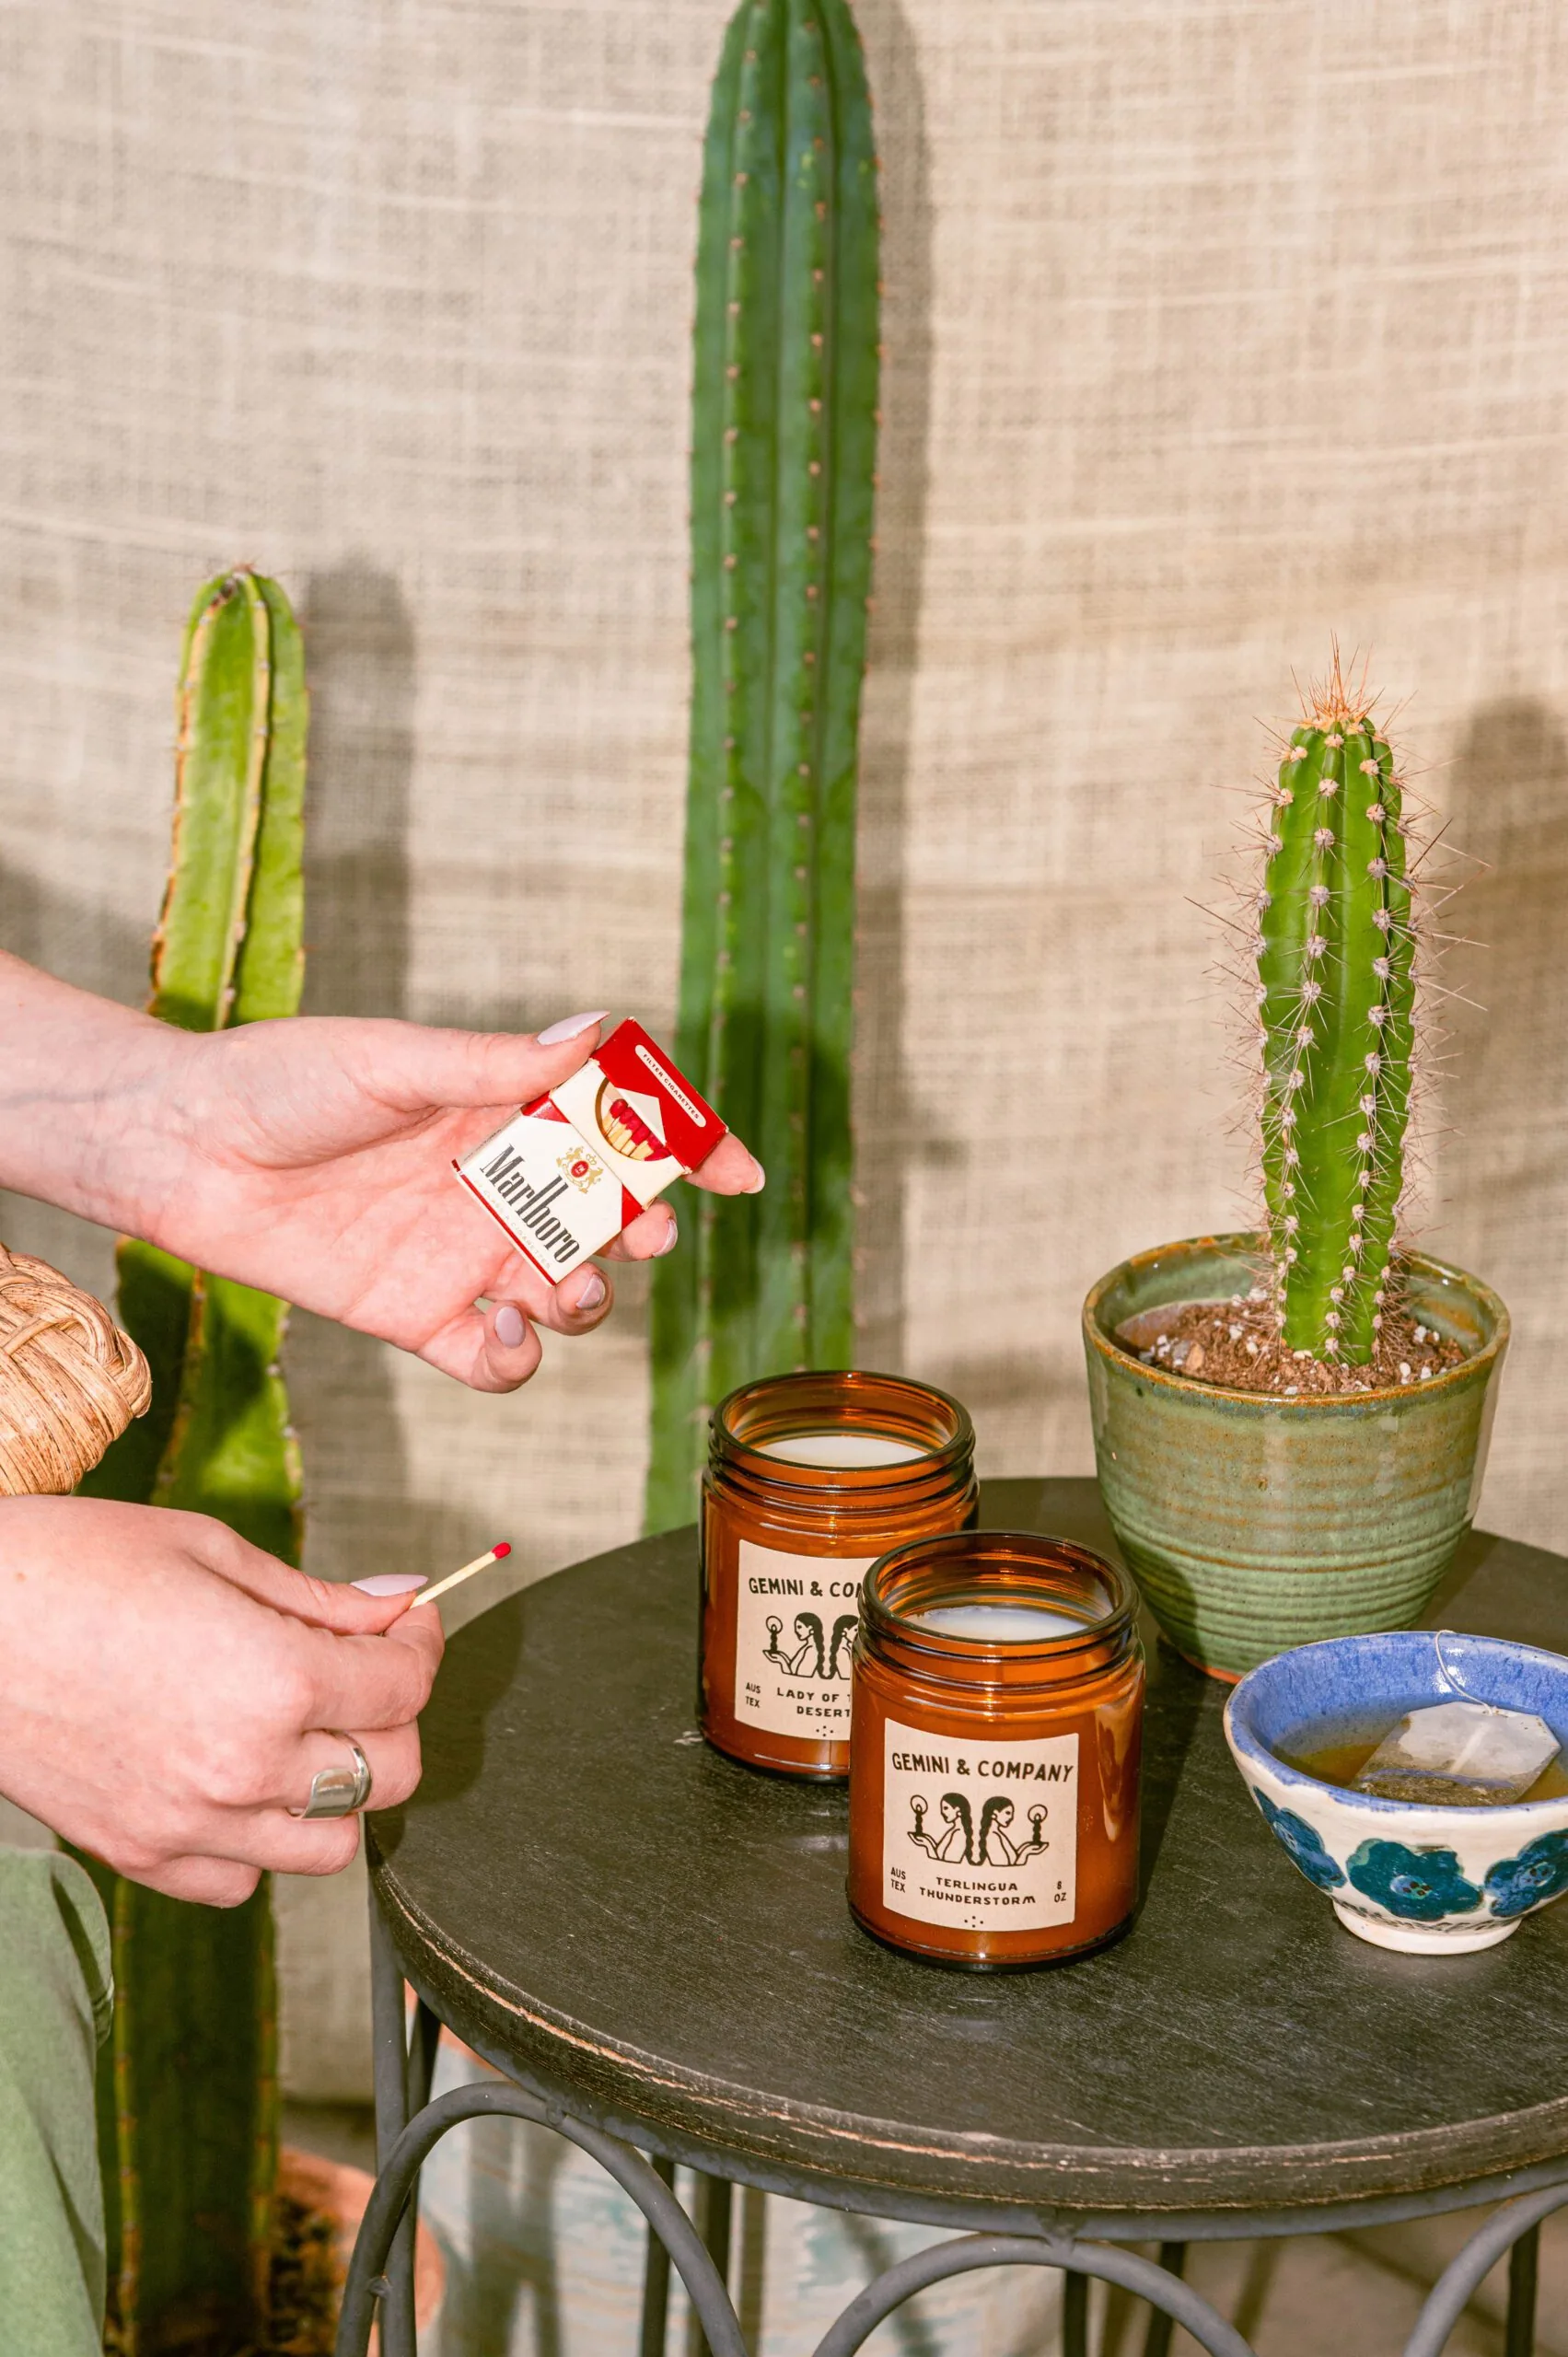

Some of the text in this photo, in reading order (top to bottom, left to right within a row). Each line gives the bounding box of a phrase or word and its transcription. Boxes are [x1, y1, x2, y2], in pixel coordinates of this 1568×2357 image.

[643, 1053, 700, 1120] FILTER CIGARETTES
[479, 1142, 581, 1264] Marlboro
[748, 1576, 804, 1596] GEMINI
[809, 1580, 824, 1597] &
[745, 1681, 761, 1695] AUS
[776, 1687, 815, 1701] LADY
[821, 1692, 840, 1703] OF
[745, 1695, 761, 1709] TEX
[796, 1705, 851, 1718] DESERT
[891, 1752, 1074, 1782] GEMINI & COMPANY
[890, 1866, 907, 1880] AUS
[890, 1878, 906, 1894] TEX
[935, 1876, 1018, 1891] TERLINGUA
[1056, 1880, 1063, 1890] 8
[919, 1887, 1036, 1906] THUNDERSTORM
[1053, 1892, 1067, 1903] OZ
